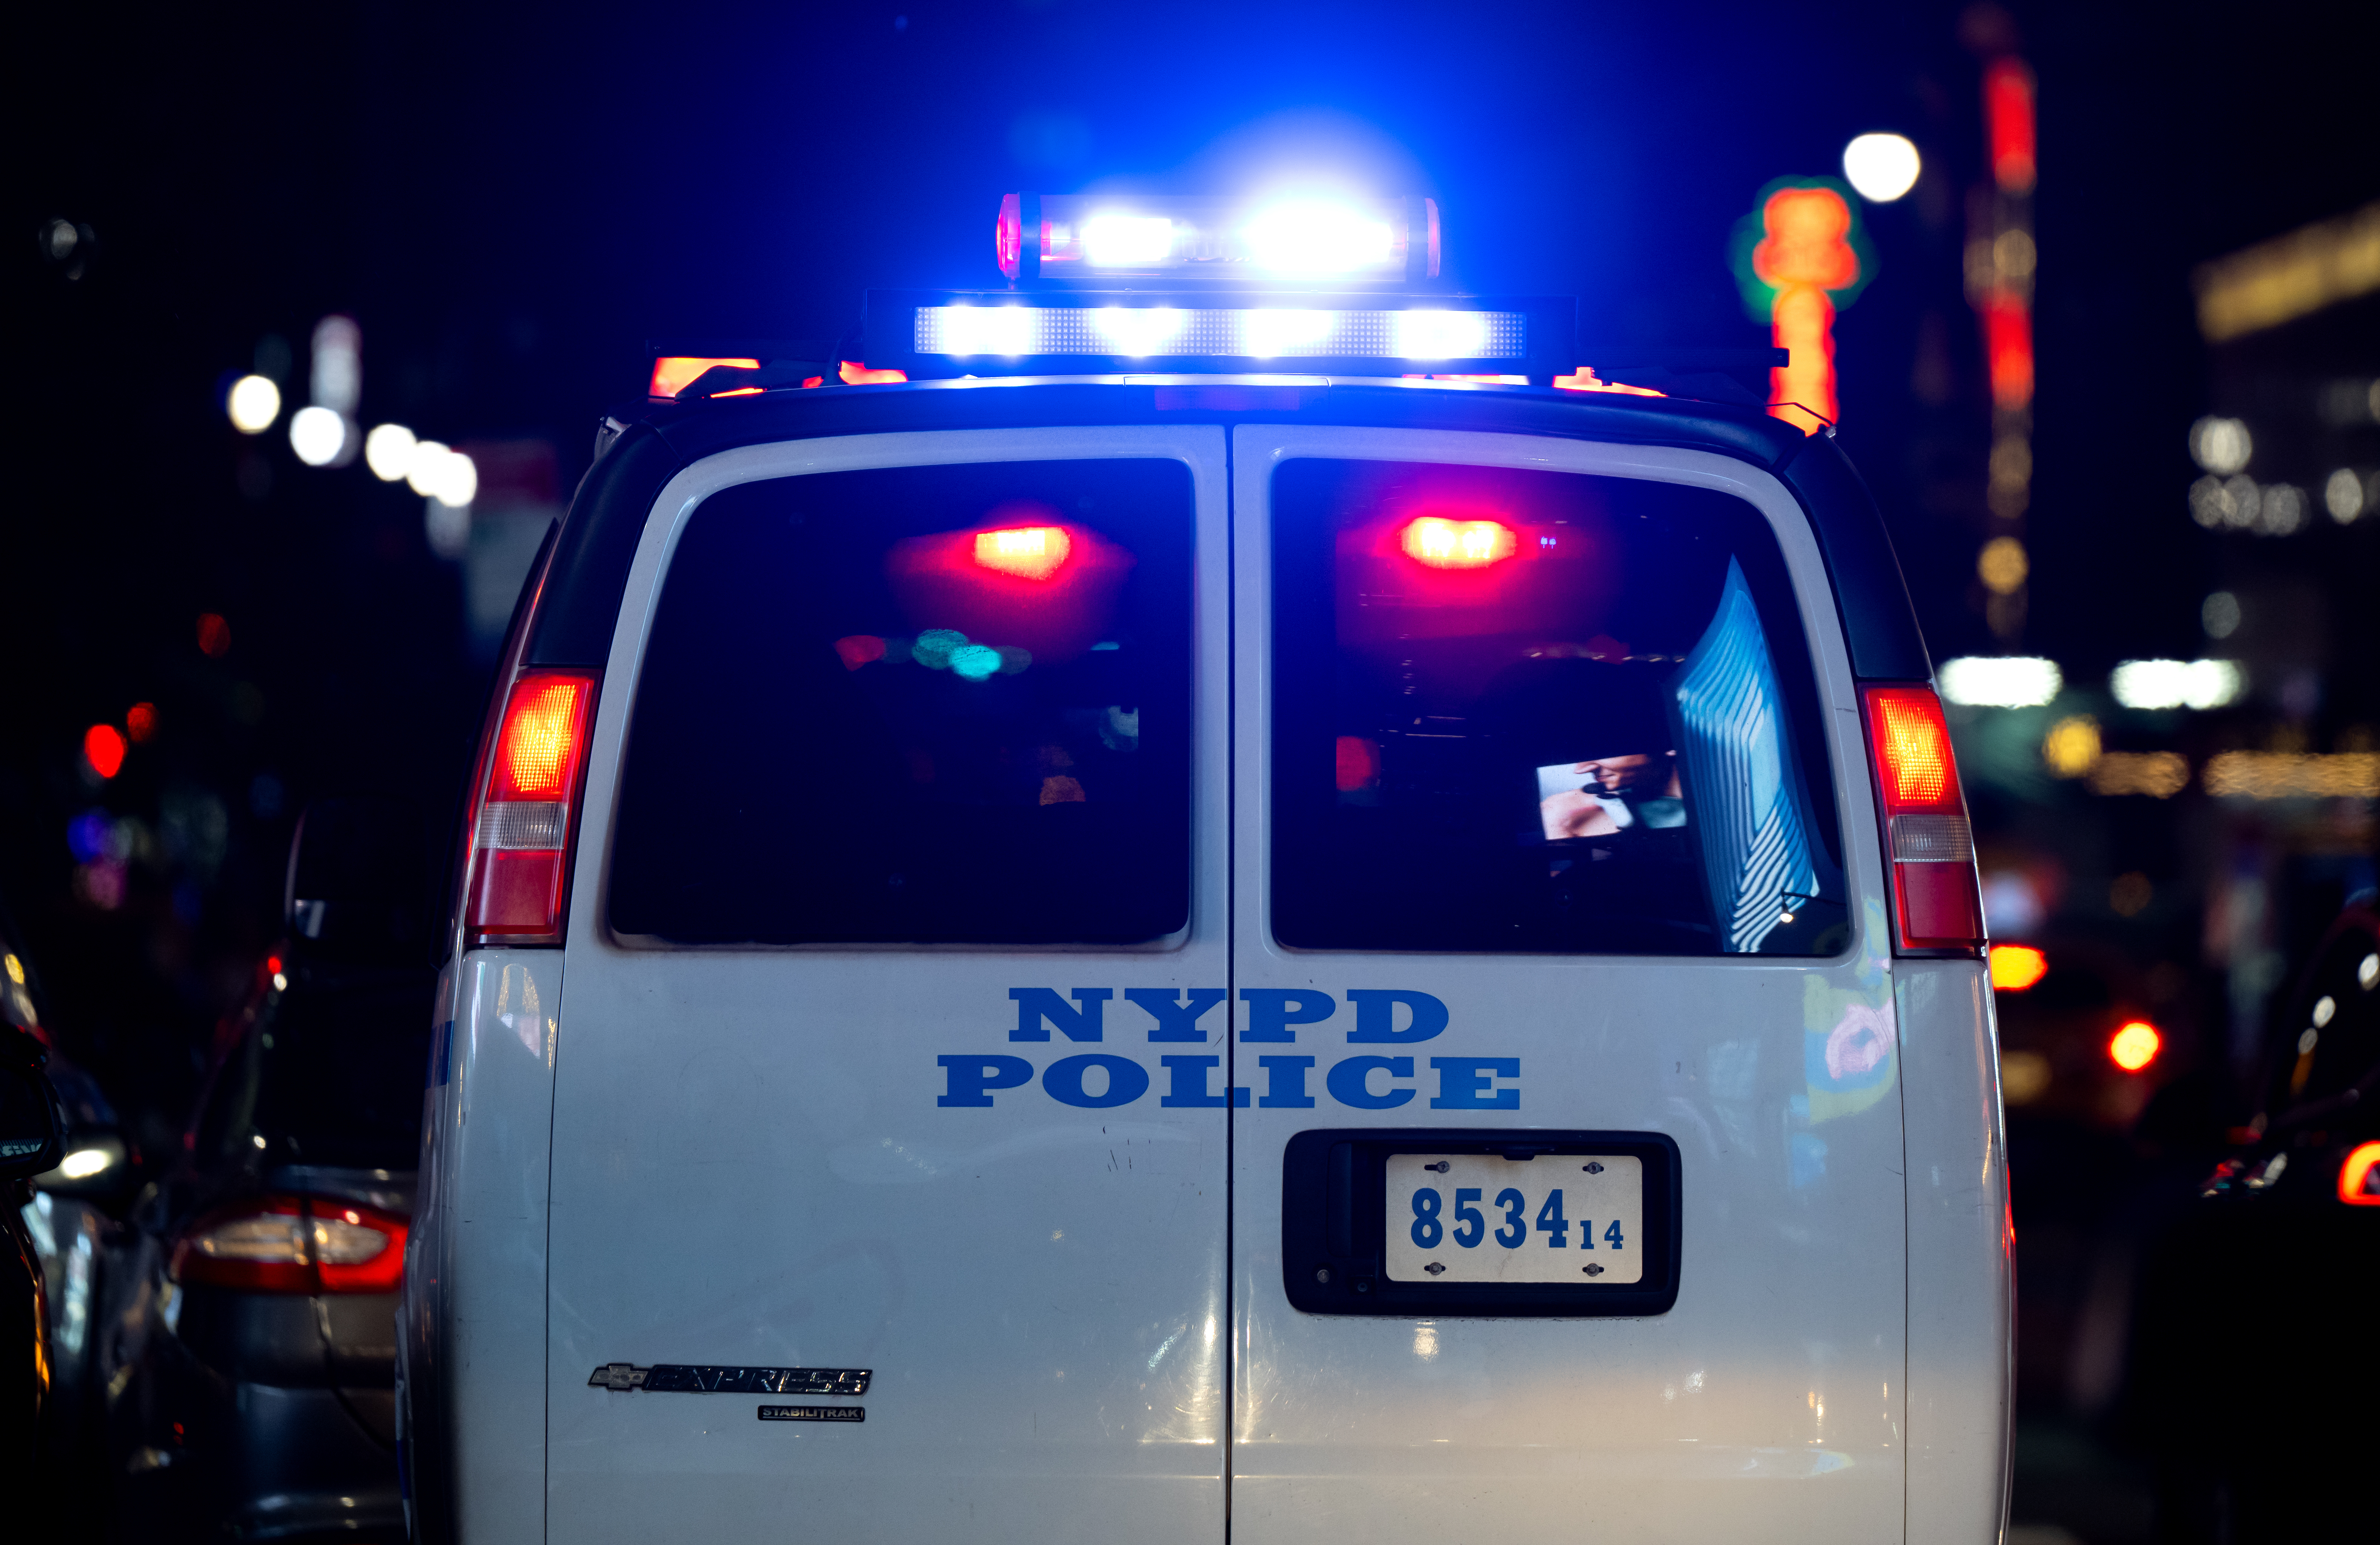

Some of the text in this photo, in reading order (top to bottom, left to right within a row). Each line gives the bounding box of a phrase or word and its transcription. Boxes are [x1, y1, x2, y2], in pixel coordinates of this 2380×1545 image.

[1008, 987, 1449, 1044] NYPD
[937, 1054, 1520, 1111] POLICE
[1411, 1187, 1624, 1249] 8534 14
[645, 1365, 869, 1393] EXPRESS
[762, 1408, 858, 1418] STABILITRAK
